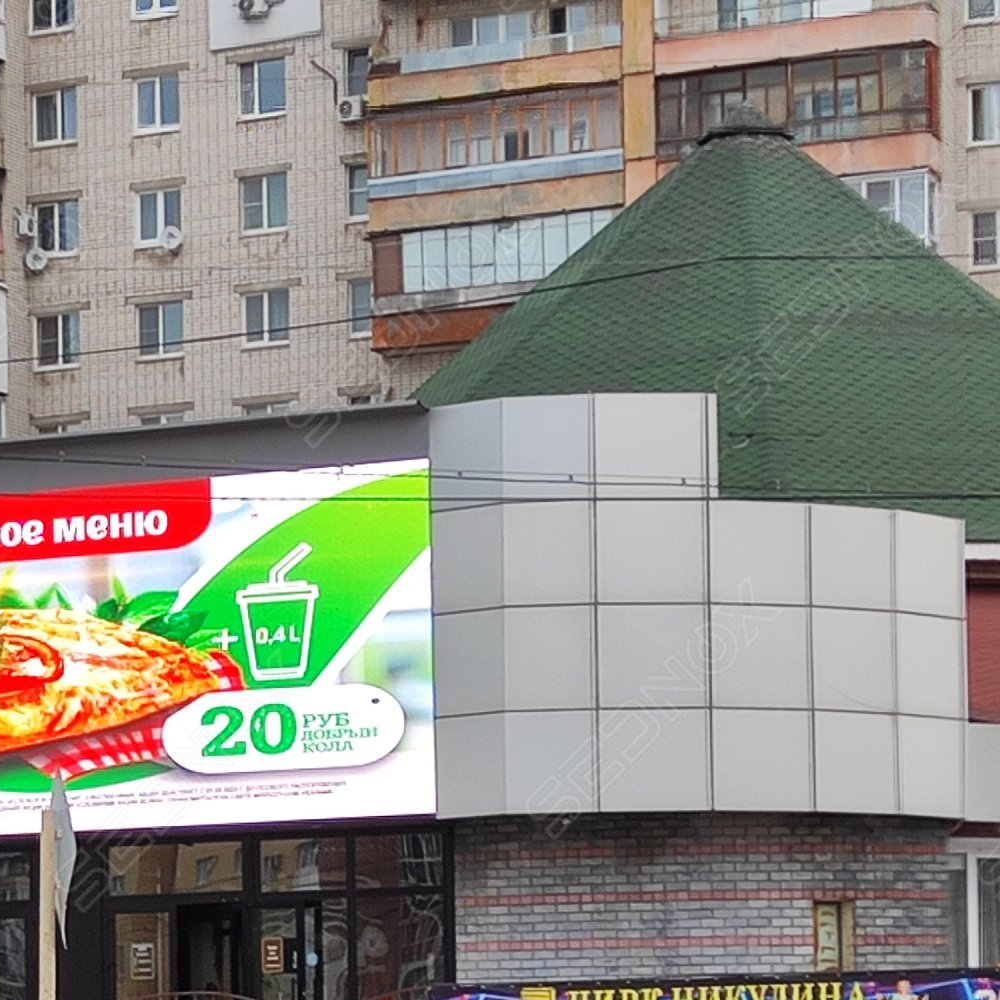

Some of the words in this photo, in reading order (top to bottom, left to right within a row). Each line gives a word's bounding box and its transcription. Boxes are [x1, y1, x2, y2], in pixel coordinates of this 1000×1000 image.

[53, 509, 168, 543] меню
[200, 703, 297, 758] 20
[302, 712, 350, 729] РУБ
[302, 740, 354, 753] КОЛА
